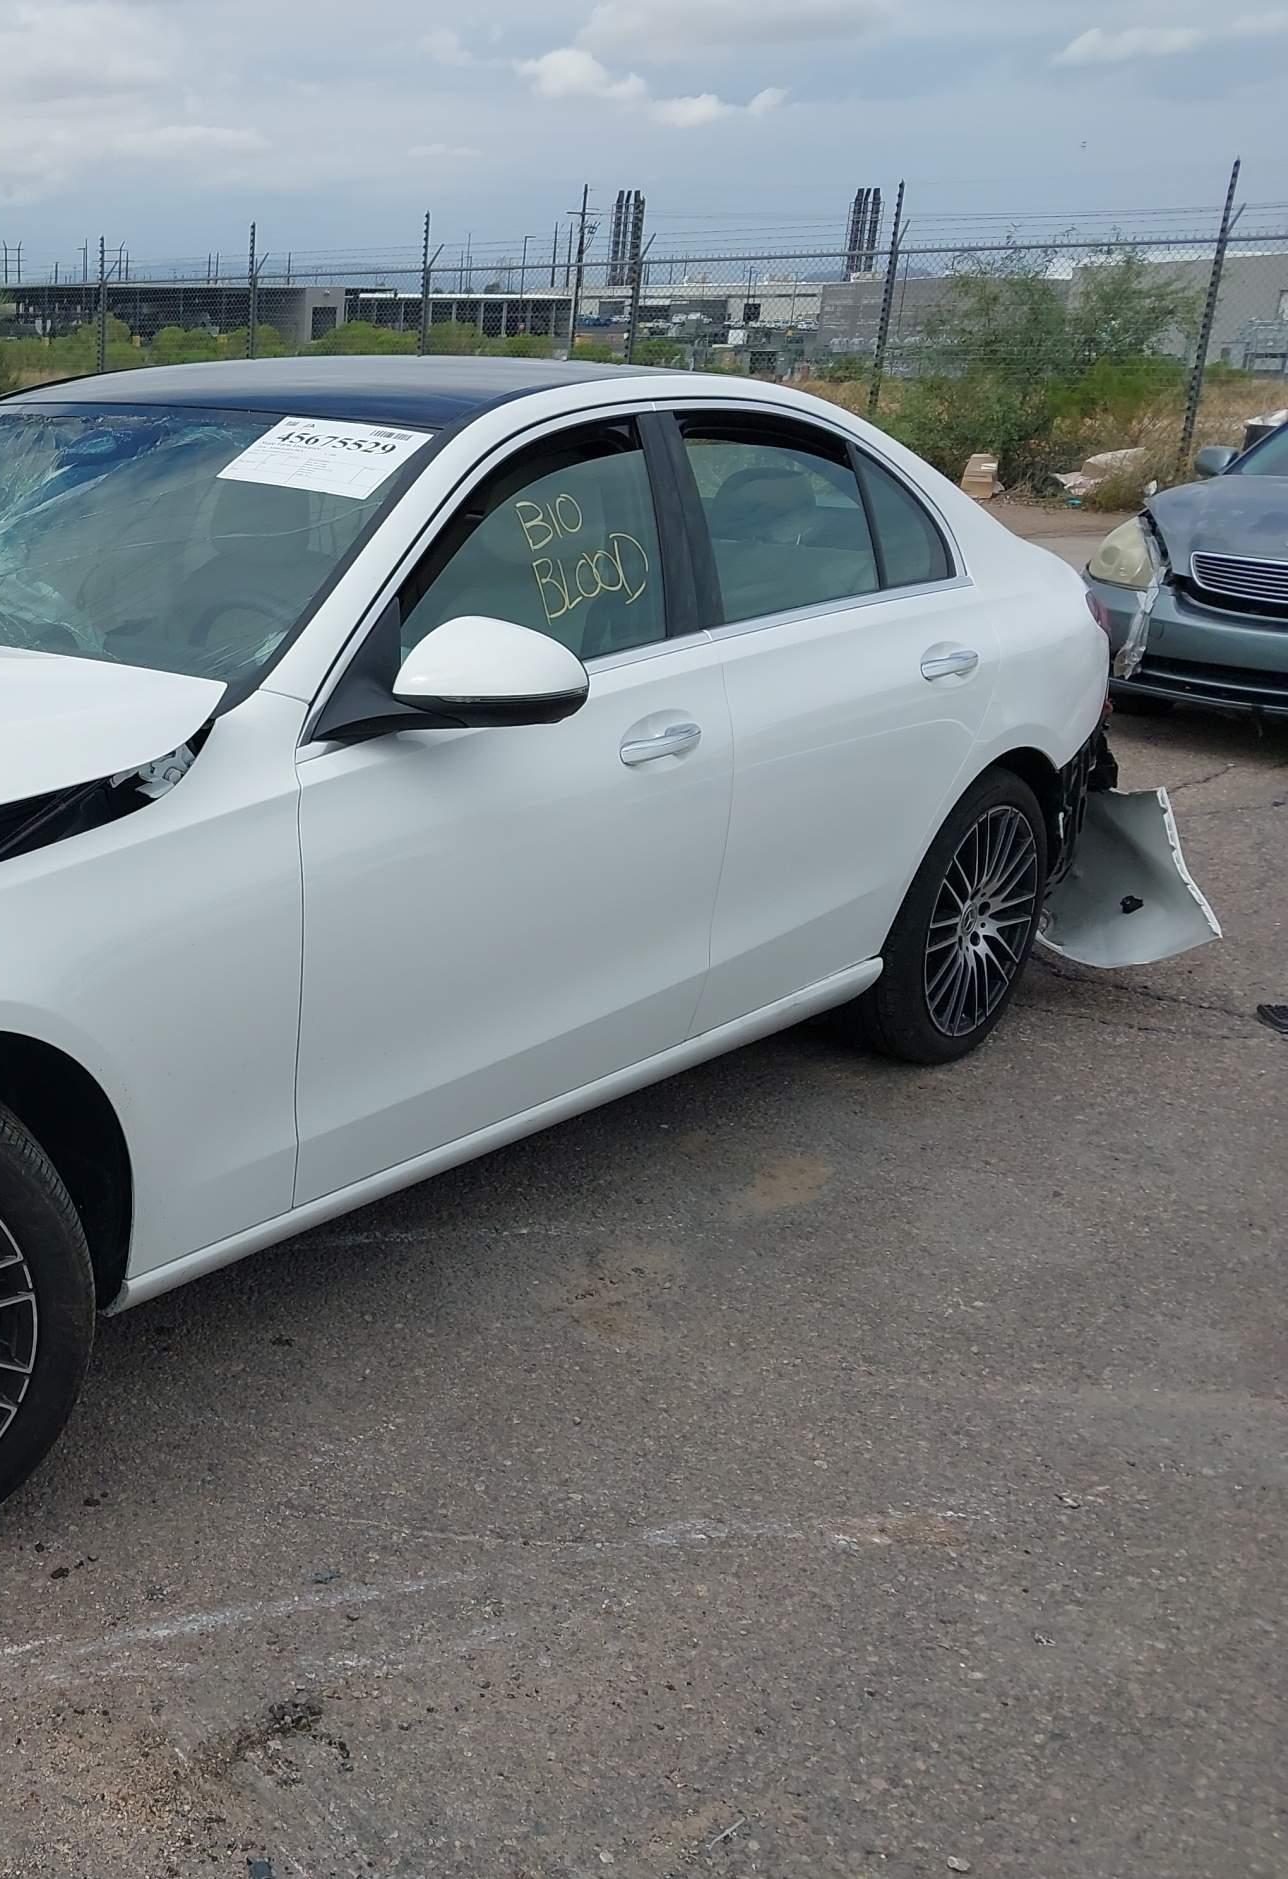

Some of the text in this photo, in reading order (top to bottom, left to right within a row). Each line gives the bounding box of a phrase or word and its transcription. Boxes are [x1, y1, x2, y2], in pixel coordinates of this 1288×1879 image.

[276, 431, 397, 455] 45675529
[515, 494, 583, 552] BIO
[532, 533, 649, 626] BLOOD
